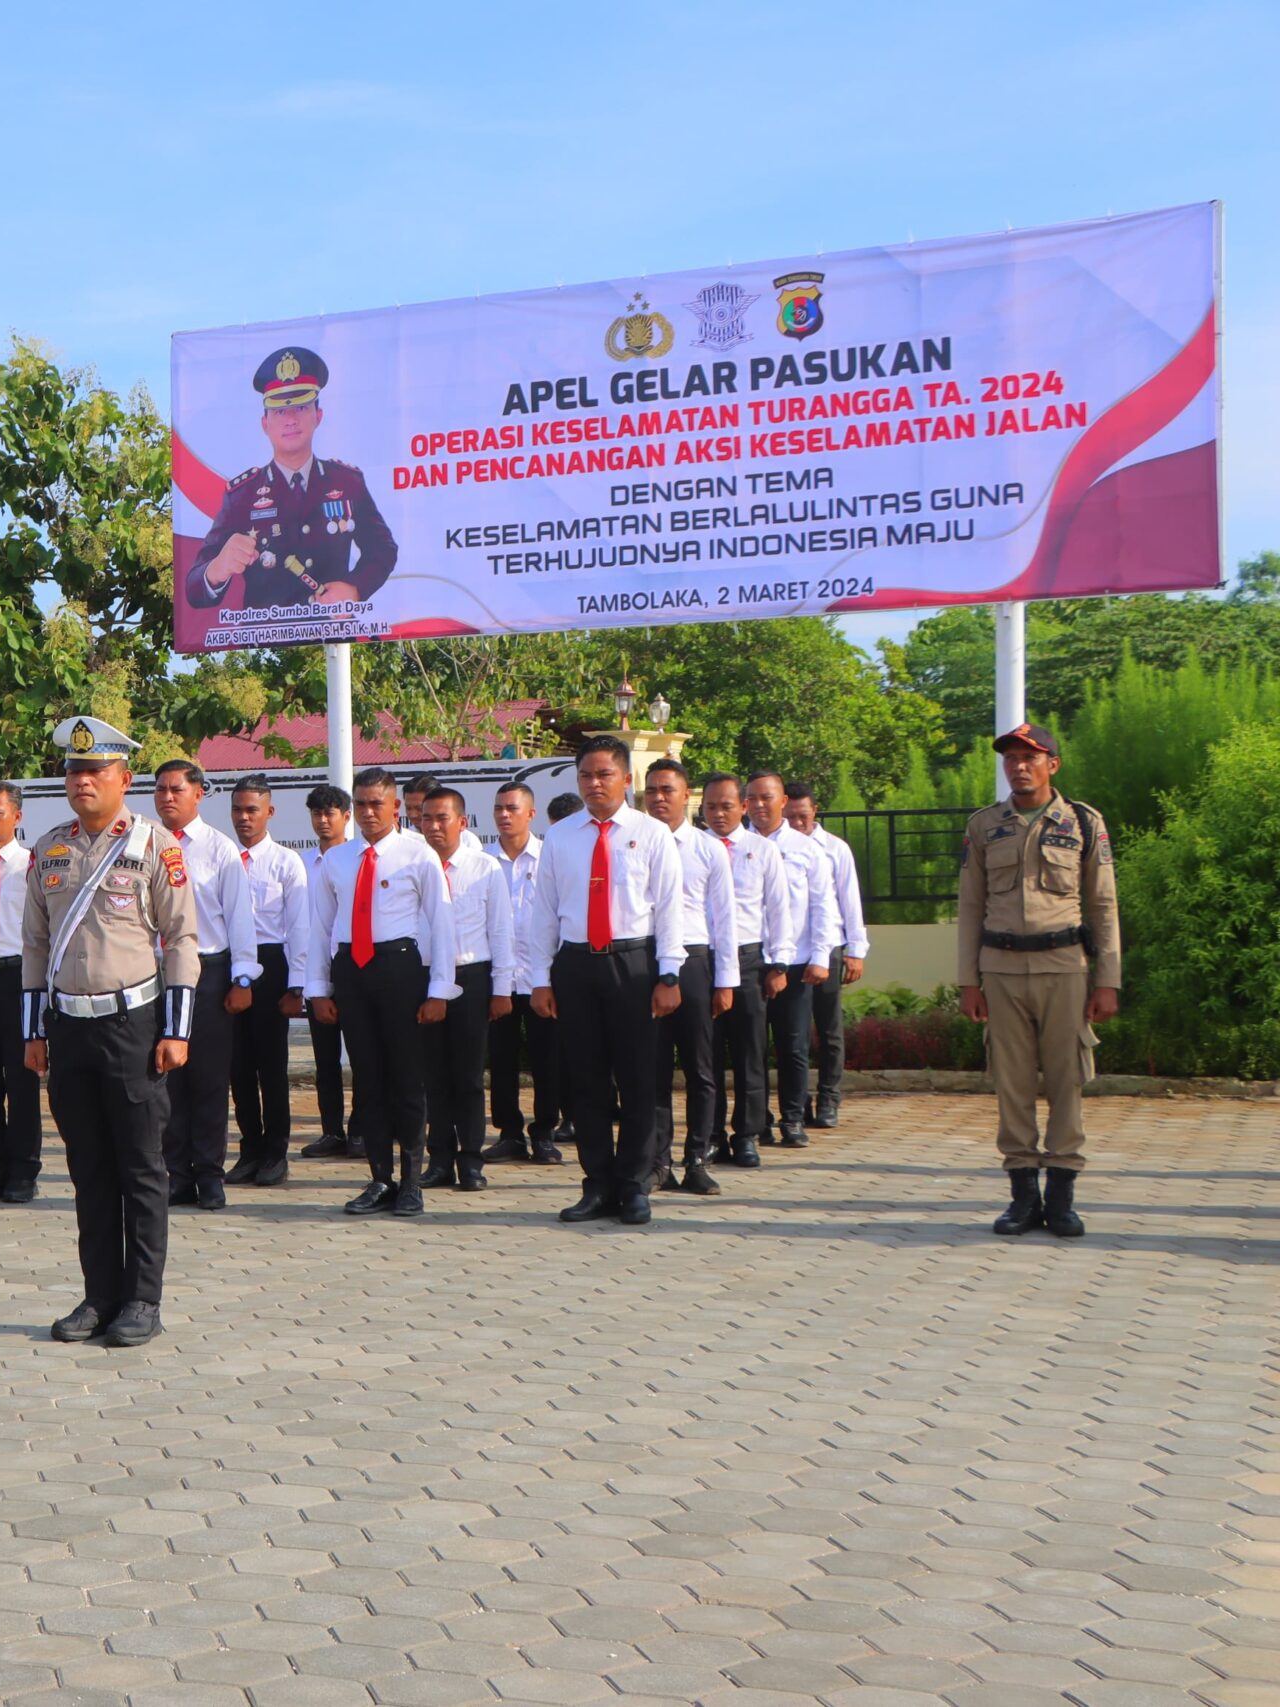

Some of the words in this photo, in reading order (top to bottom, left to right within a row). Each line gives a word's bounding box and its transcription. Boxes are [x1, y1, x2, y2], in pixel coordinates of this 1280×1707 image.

[502, 376, 598, 416] APEL
[610, 361, 737, 405] GELAR
[750, 337, 951, 391] PASUKAN
[411, 425, 524, 457] OPERASI
[532, 403, 739, 446] KESELAMATAN
[748, 386, 914, 425] TURANGGA
[923, 381, 970, 408] TA.
[980, 370, 1064, 402] 2024
[393, 463, 448, 490] DAN
[456, 443, 665, 484] PENCANANGAN
[674, 436, 741, 464] AKSI
[750, 413, 975, 458] KESELAMATAN
[985, 402, 1087, 436] JALAN
[610, 476, 737, 507] DENGAN
[745, 467, 834, 495] TEMA
[446, 513, 661, 549] KESELAMATAN
[670, 491, 921, 532] BERLALULINTAS
[930, 482, 1024, 511] GUNA
[487, 540, 701, 575] TERHUJUDNYA
[709, 526, 878, 559] INDONESIA
[886, 519, 975, 546] MAJU
[220, 608, 268, 624] Kapolres
[271, 604, 309, 618] Sumba
[313, 602, 342, 614] Barat
[345, 601, 374, 616] Daya
[577, 588, 708, 614] TAMBOLAKA,
[717, 587, 731, 605] 2
[738, 581, 810, 604] MARET
[817, 577, 875, 598] 2024
[205, 634, 231, 646] AKBP
[233, 630, 256, 643] SIGIT
[114, 859, 144, 871] OLRI
